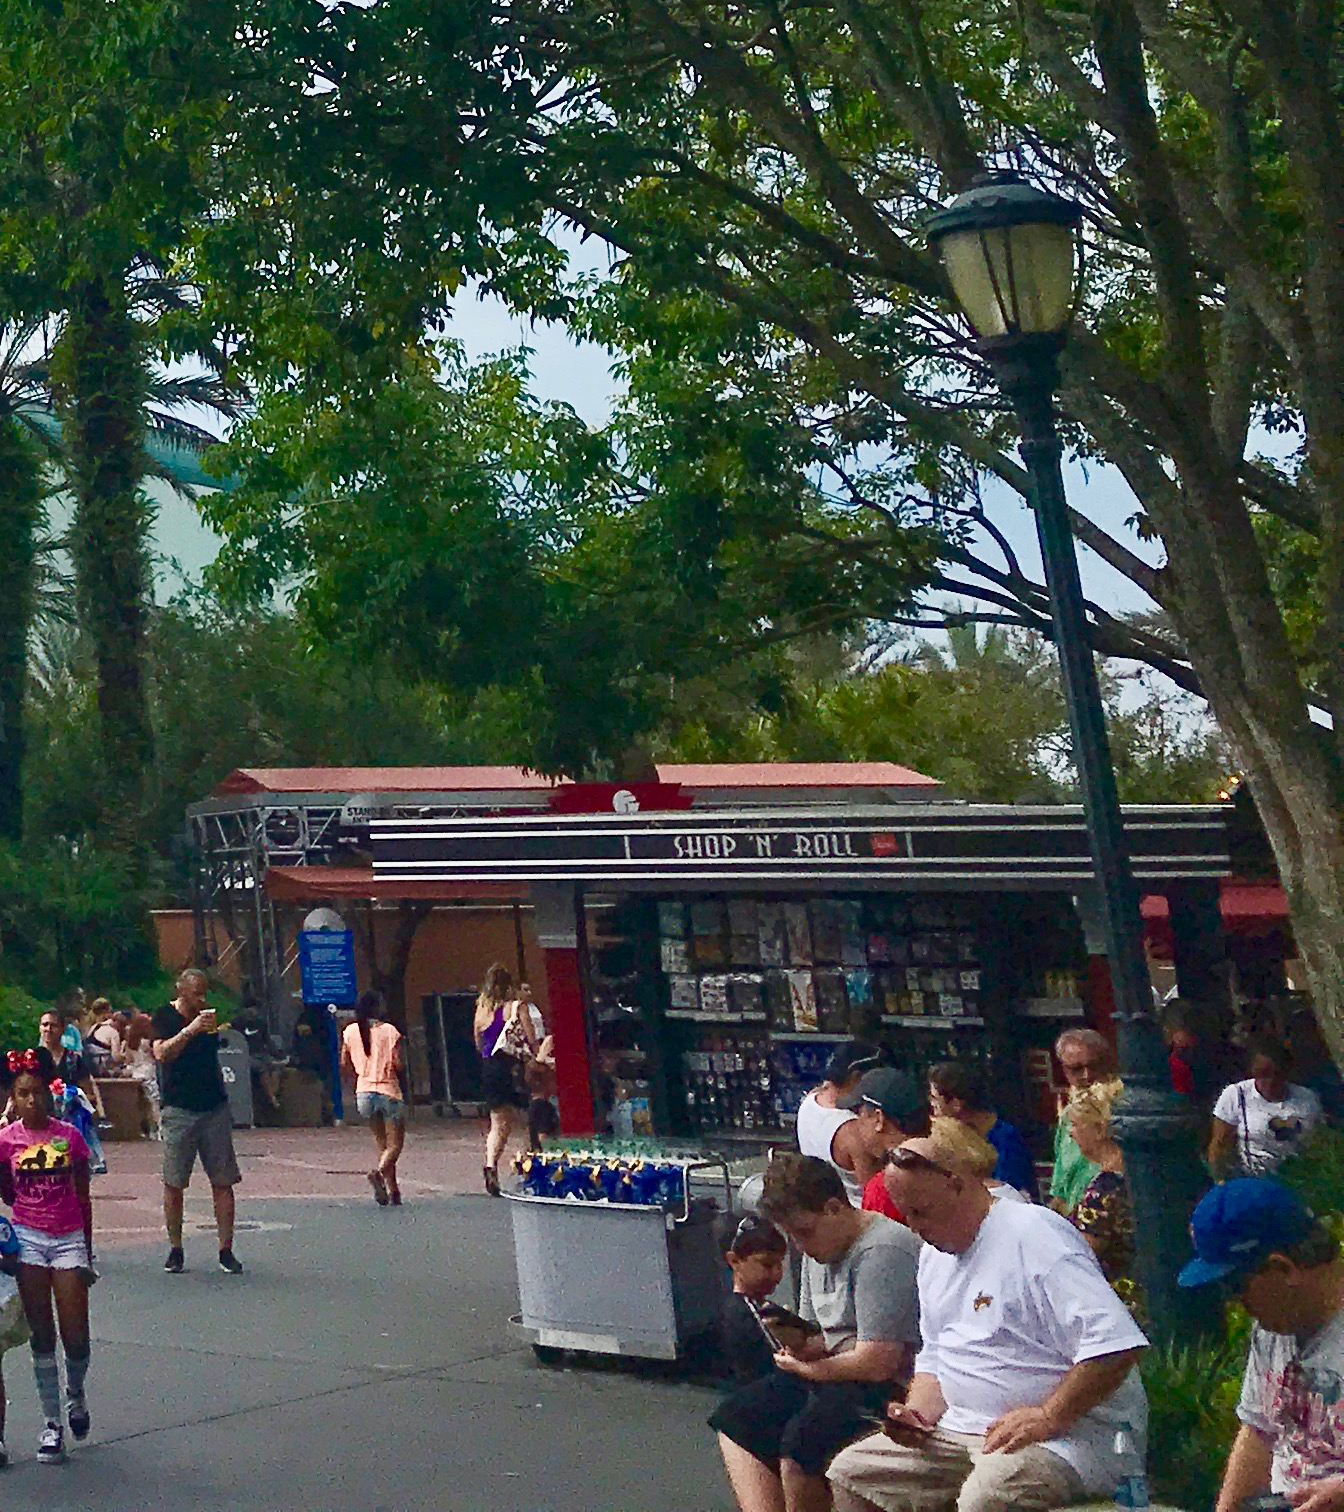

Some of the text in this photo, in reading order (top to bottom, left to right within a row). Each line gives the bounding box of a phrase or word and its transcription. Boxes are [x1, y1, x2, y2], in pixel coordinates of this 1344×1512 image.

[674, 834, 859, 858] SHOP 'N' ROLL
